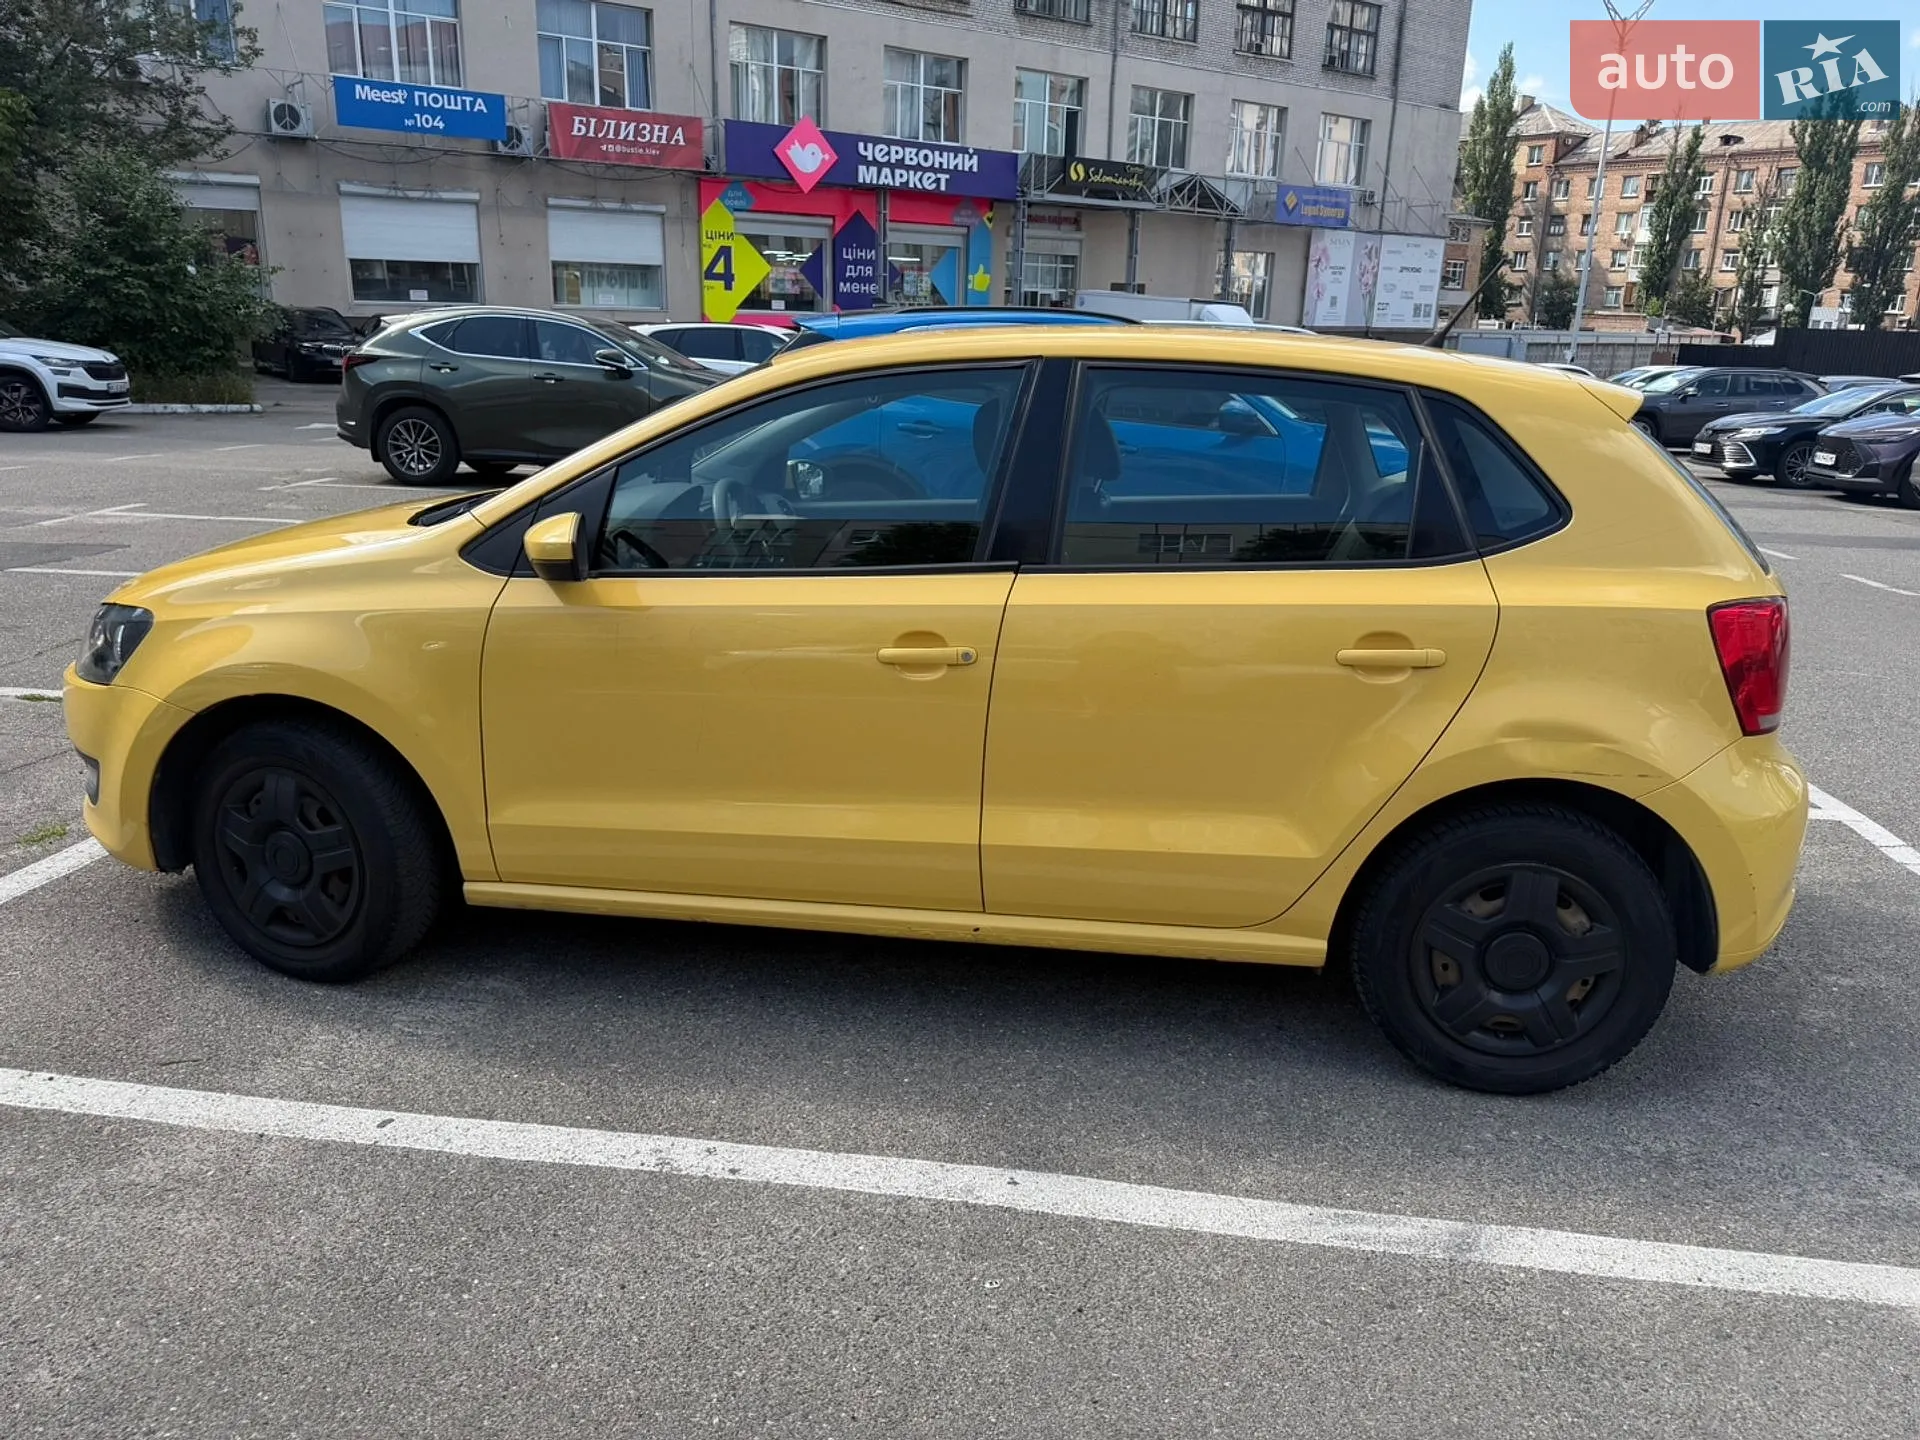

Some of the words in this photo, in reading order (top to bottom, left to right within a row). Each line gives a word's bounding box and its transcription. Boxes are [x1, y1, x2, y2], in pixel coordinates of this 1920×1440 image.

[355, 84, 406, 105] Meest
[414, 91, 488, 113] ПОШТА
[571, 115, 686, 146] БІЛИЗНА
[857, 142, 979, 173] ЧЕРВОНИЙ
[857, 165, 950, 191] МАРКЕТ
[842, 243, 876, 261] ціни
[704, 246, 735, 291] 4
[845, 265, 873, 278] для
[839, 282, 879, 294] мене
